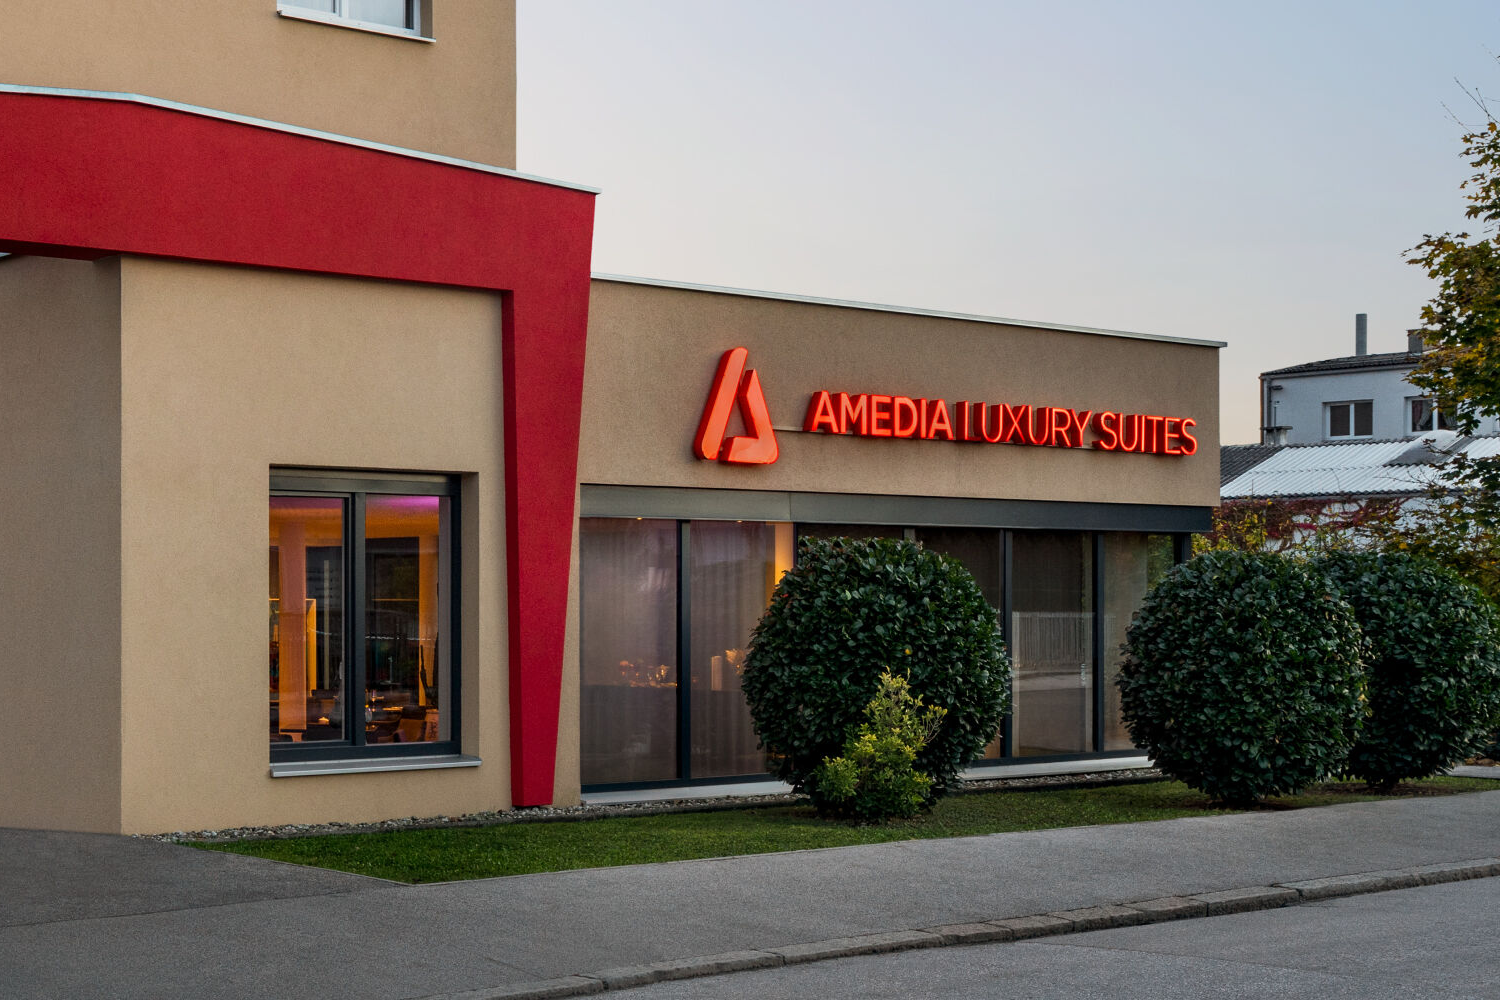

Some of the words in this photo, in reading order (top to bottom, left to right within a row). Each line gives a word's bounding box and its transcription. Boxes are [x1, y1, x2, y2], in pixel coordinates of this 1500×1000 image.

[805, 390, 954, 440] AMEDIA
[955, 400, 1093, 448] LUXURY
[1093, 411, 1199, 456] SUITES
